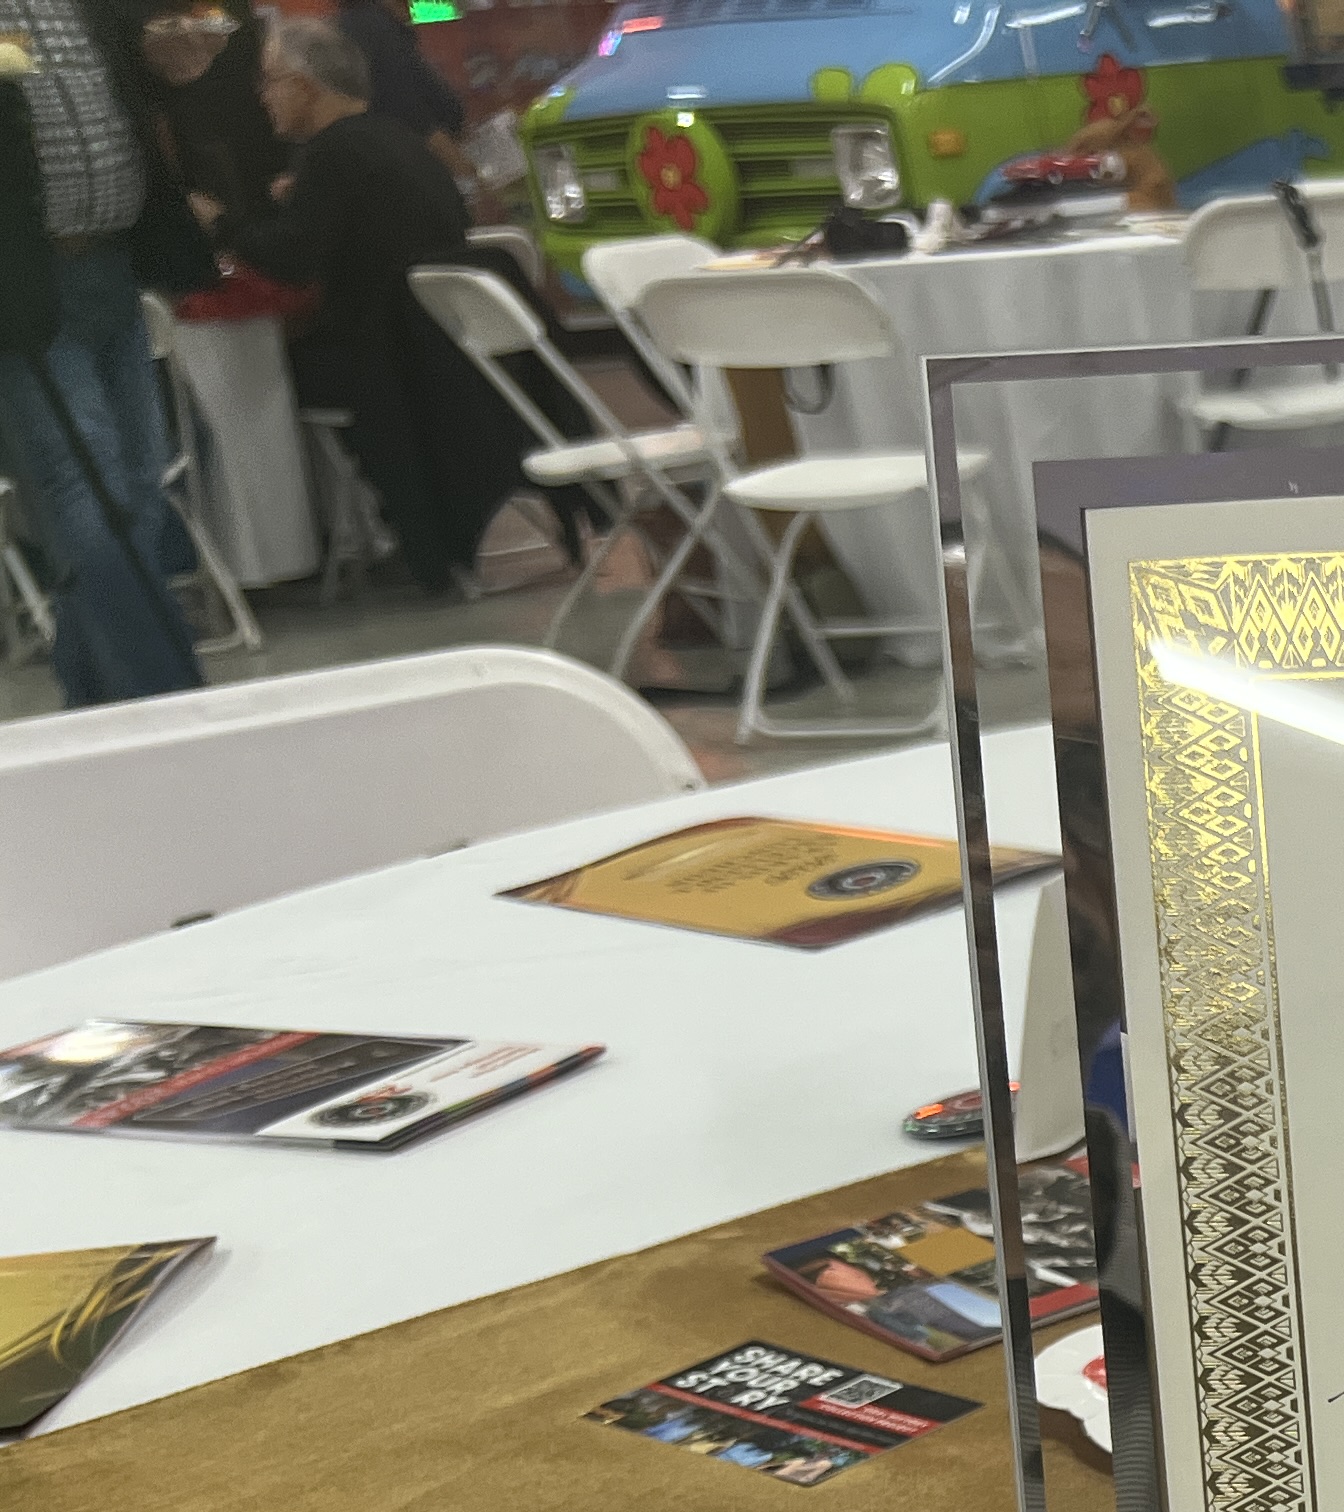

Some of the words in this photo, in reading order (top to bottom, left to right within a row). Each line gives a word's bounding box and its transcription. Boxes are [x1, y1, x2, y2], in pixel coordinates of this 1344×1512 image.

[709, 1361, 799, 1395] YOUR
[734, 1346, 844, 1387] SHARE
[675, 1371, 790, 1412] STRY
